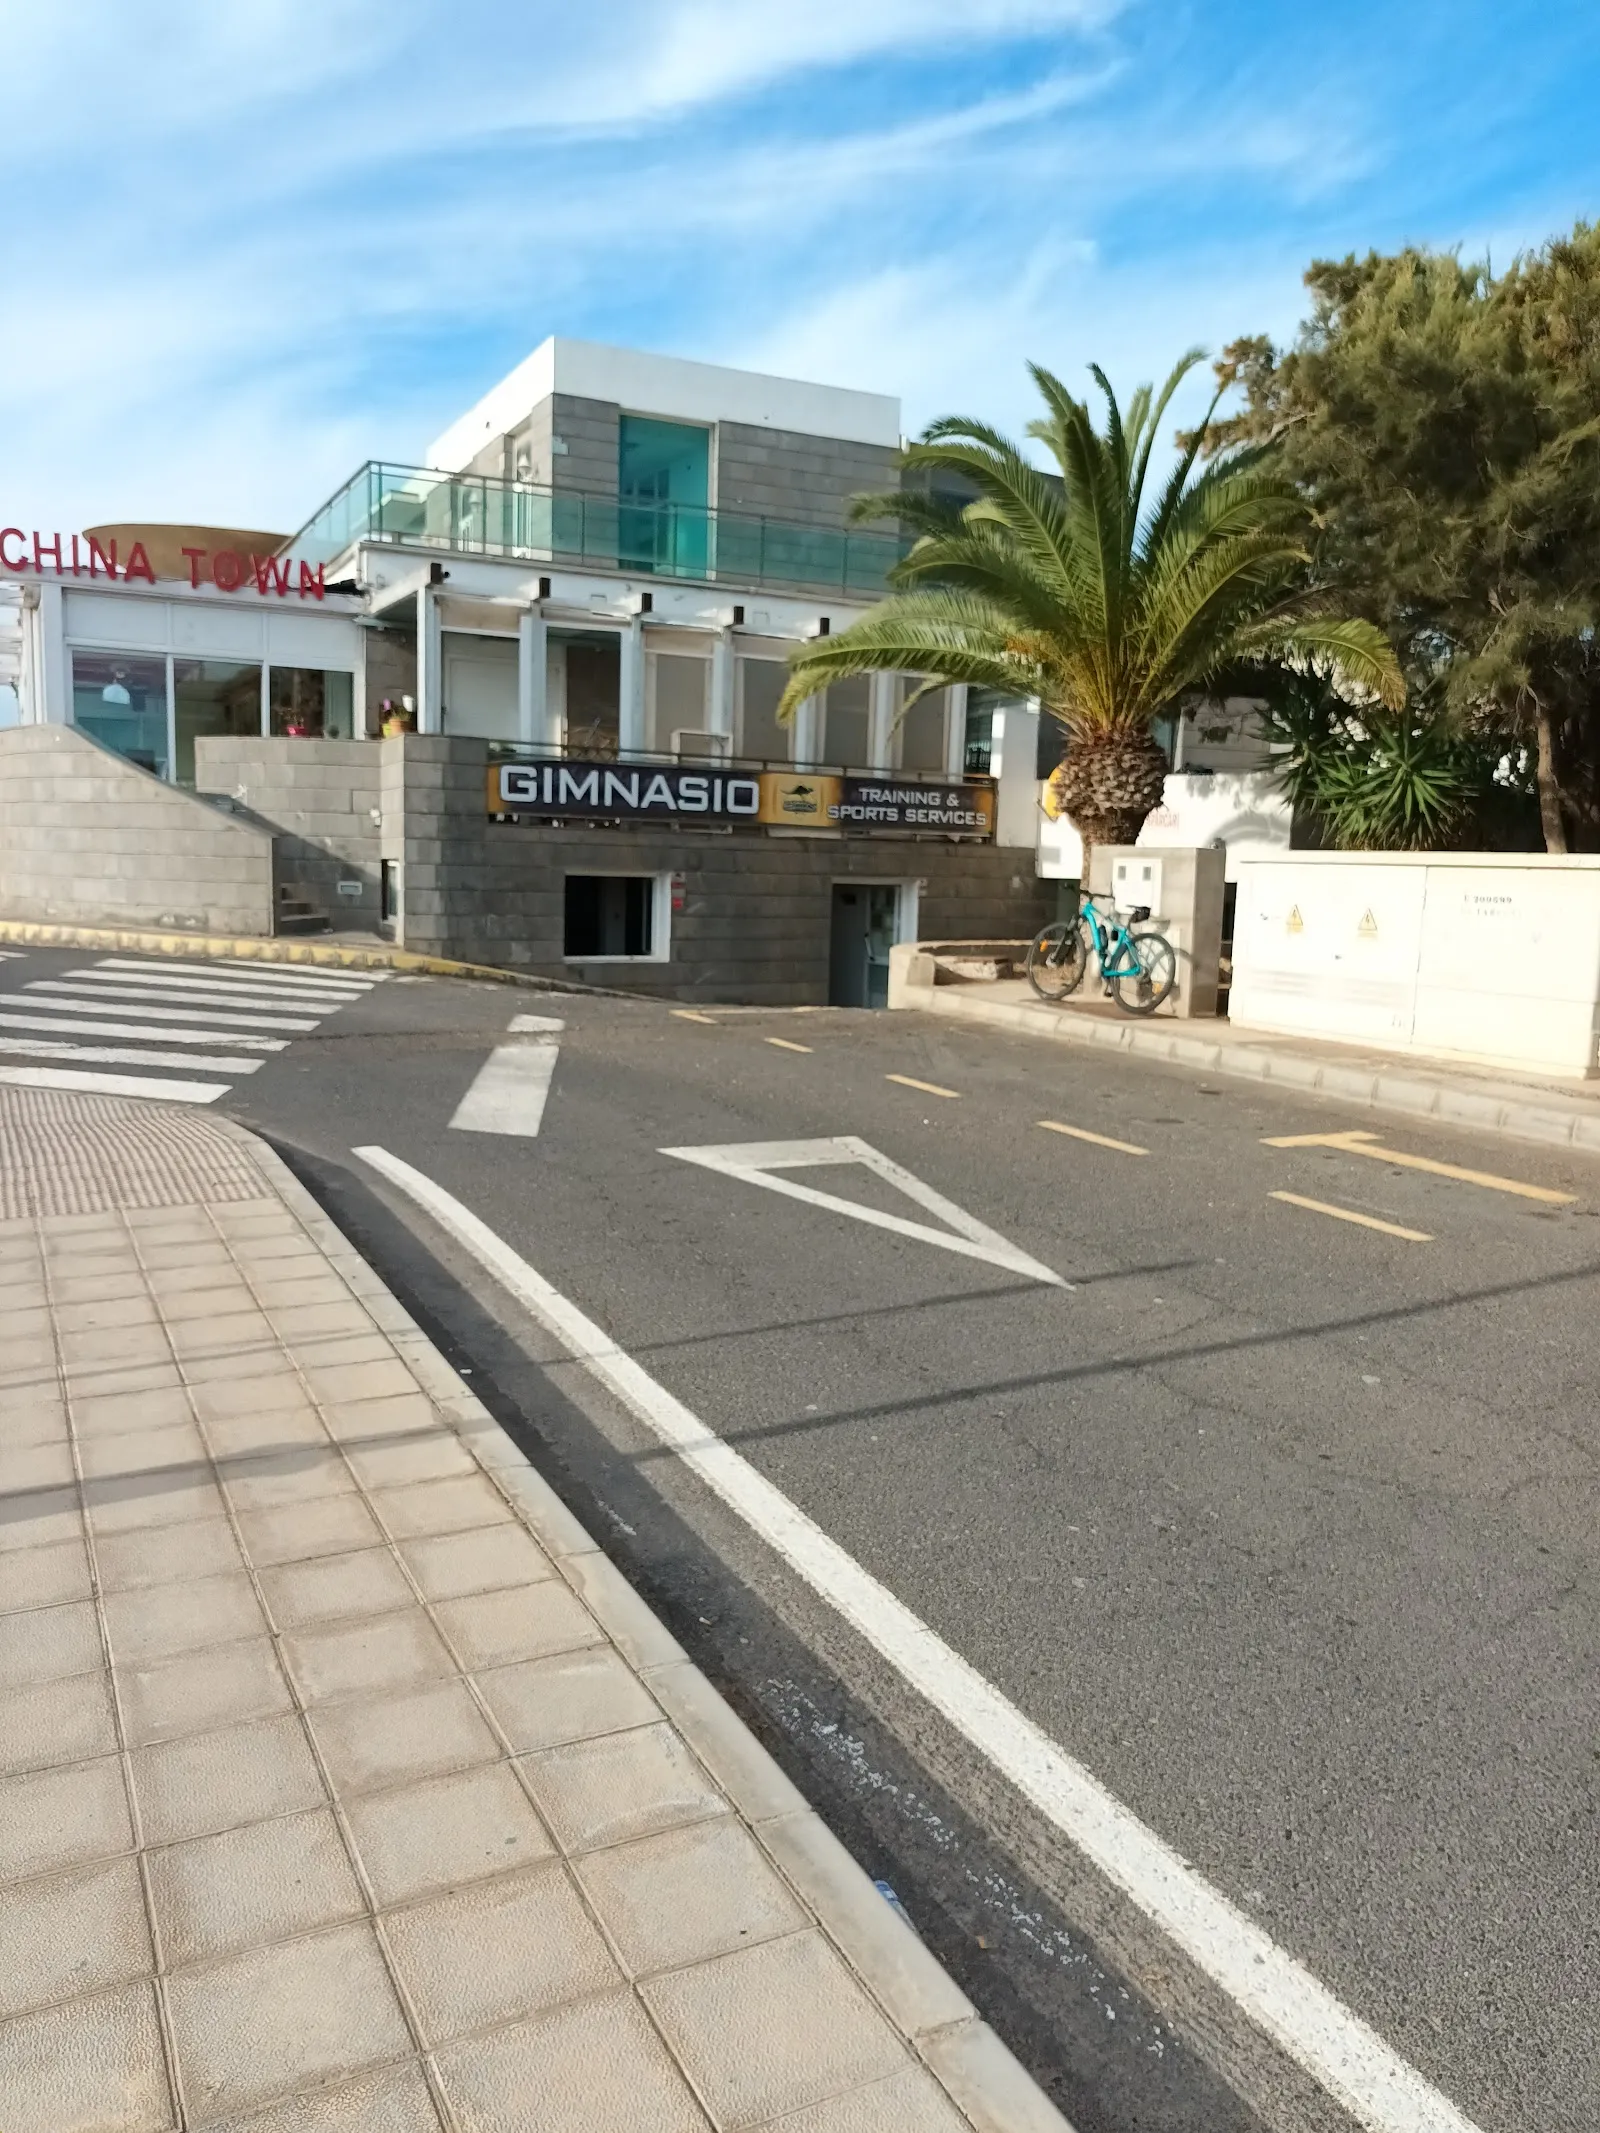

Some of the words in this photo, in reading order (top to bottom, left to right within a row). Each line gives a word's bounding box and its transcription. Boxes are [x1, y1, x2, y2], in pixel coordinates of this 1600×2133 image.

[0, 527, 156, 585] CHINA
[181, 546, 327, 601] TOWN
[500, 765, 759, 814] GIMNASIO
[858, 787, 942, 807] TRAINING
[946, 792, 960, 807] &
[827, 805, 899, 822] SPORTS
[904, 808, 987, 826] SERVICES
